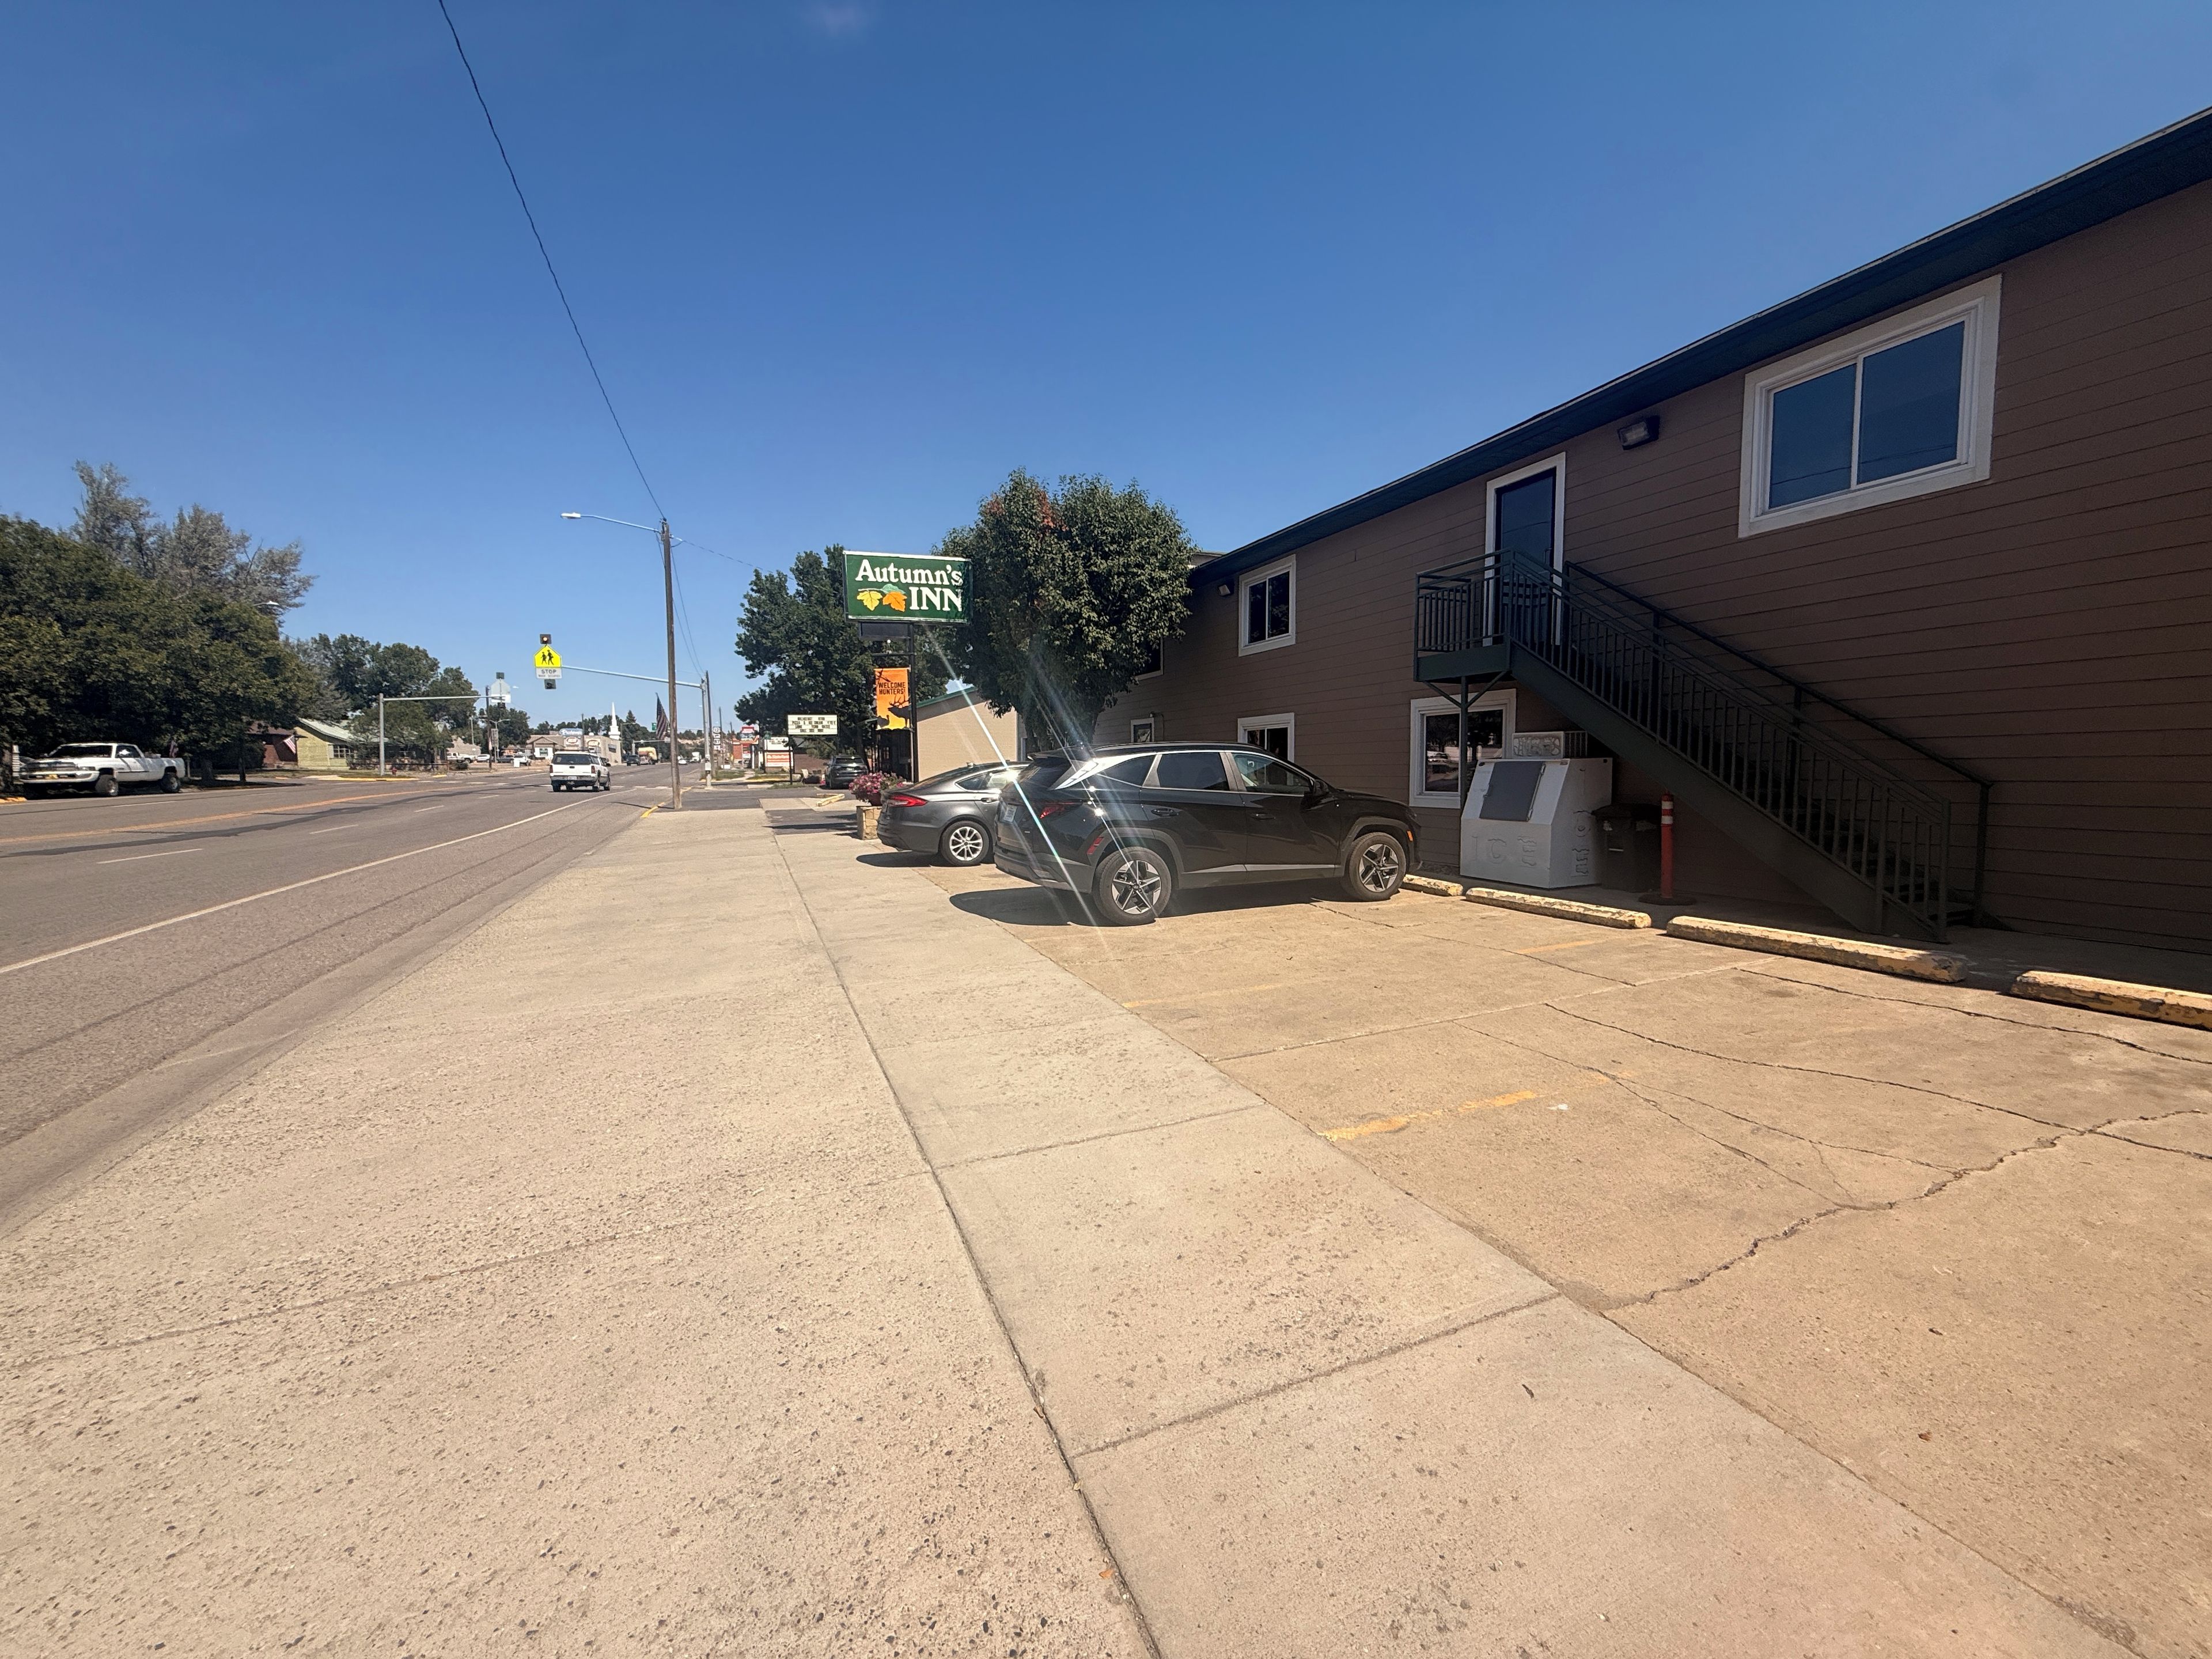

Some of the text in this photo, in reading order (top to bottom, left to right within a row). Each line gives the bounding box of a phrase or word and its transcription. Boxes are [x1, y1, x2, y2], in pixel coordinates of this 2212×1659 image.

[855, 559, 964, 586] Autumn's
[908, 586, 963, 612] INN
[1470, 835, 1537, 869] ICE
